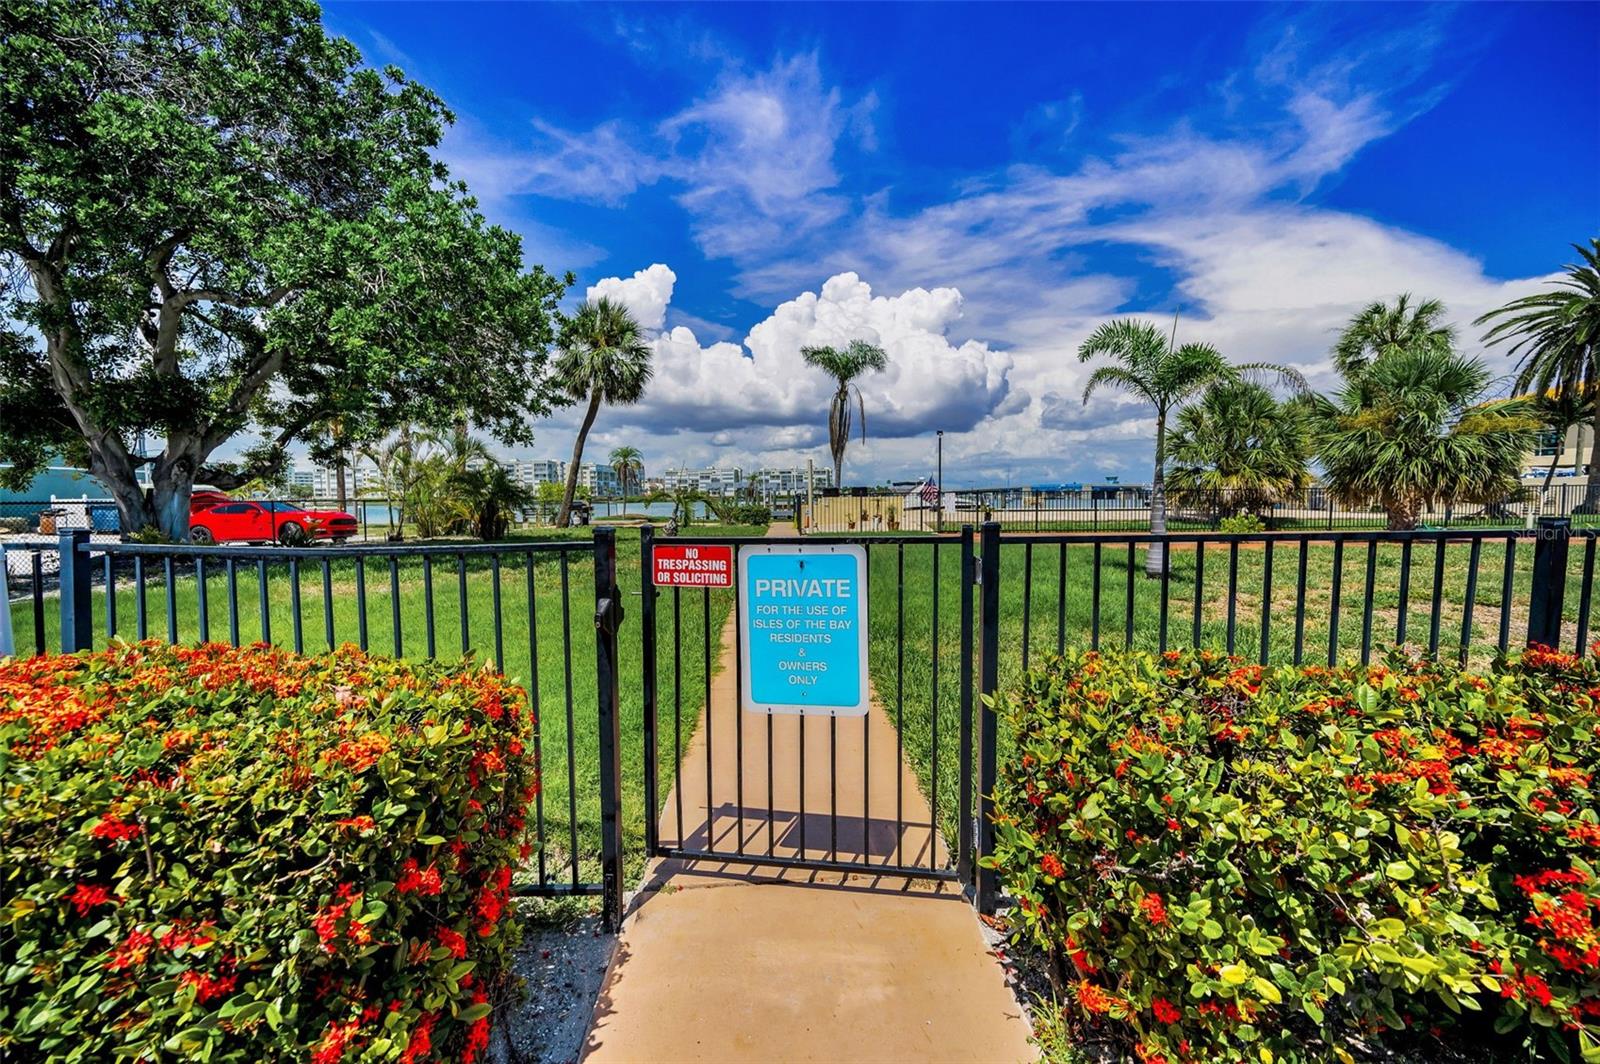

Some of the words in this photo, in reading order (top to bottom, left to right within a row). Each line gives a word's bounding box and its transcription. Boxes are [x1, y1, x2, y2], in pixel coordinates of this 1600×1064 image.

[685, 548, 699, 559] NO
[657, 559, 727, 571] TRESPASSING
[657, 572, 671, 583] OR
[673, 572, 727, 584] SOLICITING
[755, 579, 851, 598] PRIVATE
[756, 605, 779, 615] FOR
[782, 605, 803, 615] THE
[806, 605, 829, 615] USE
[832, 605, 848, 615] OF
[753, 619, 783, 629] ISLES
[786, 619, 801, 629] OF
[805, 619, 826, 629] THE
[829, 619, 852, 630] BAY
[769, 633, 832, 644] RESIDENTS
[798, 647, 806, 657] &
[778, 661, 828, 672] OWNERS
[788, 675, 818, 685] ONLY
